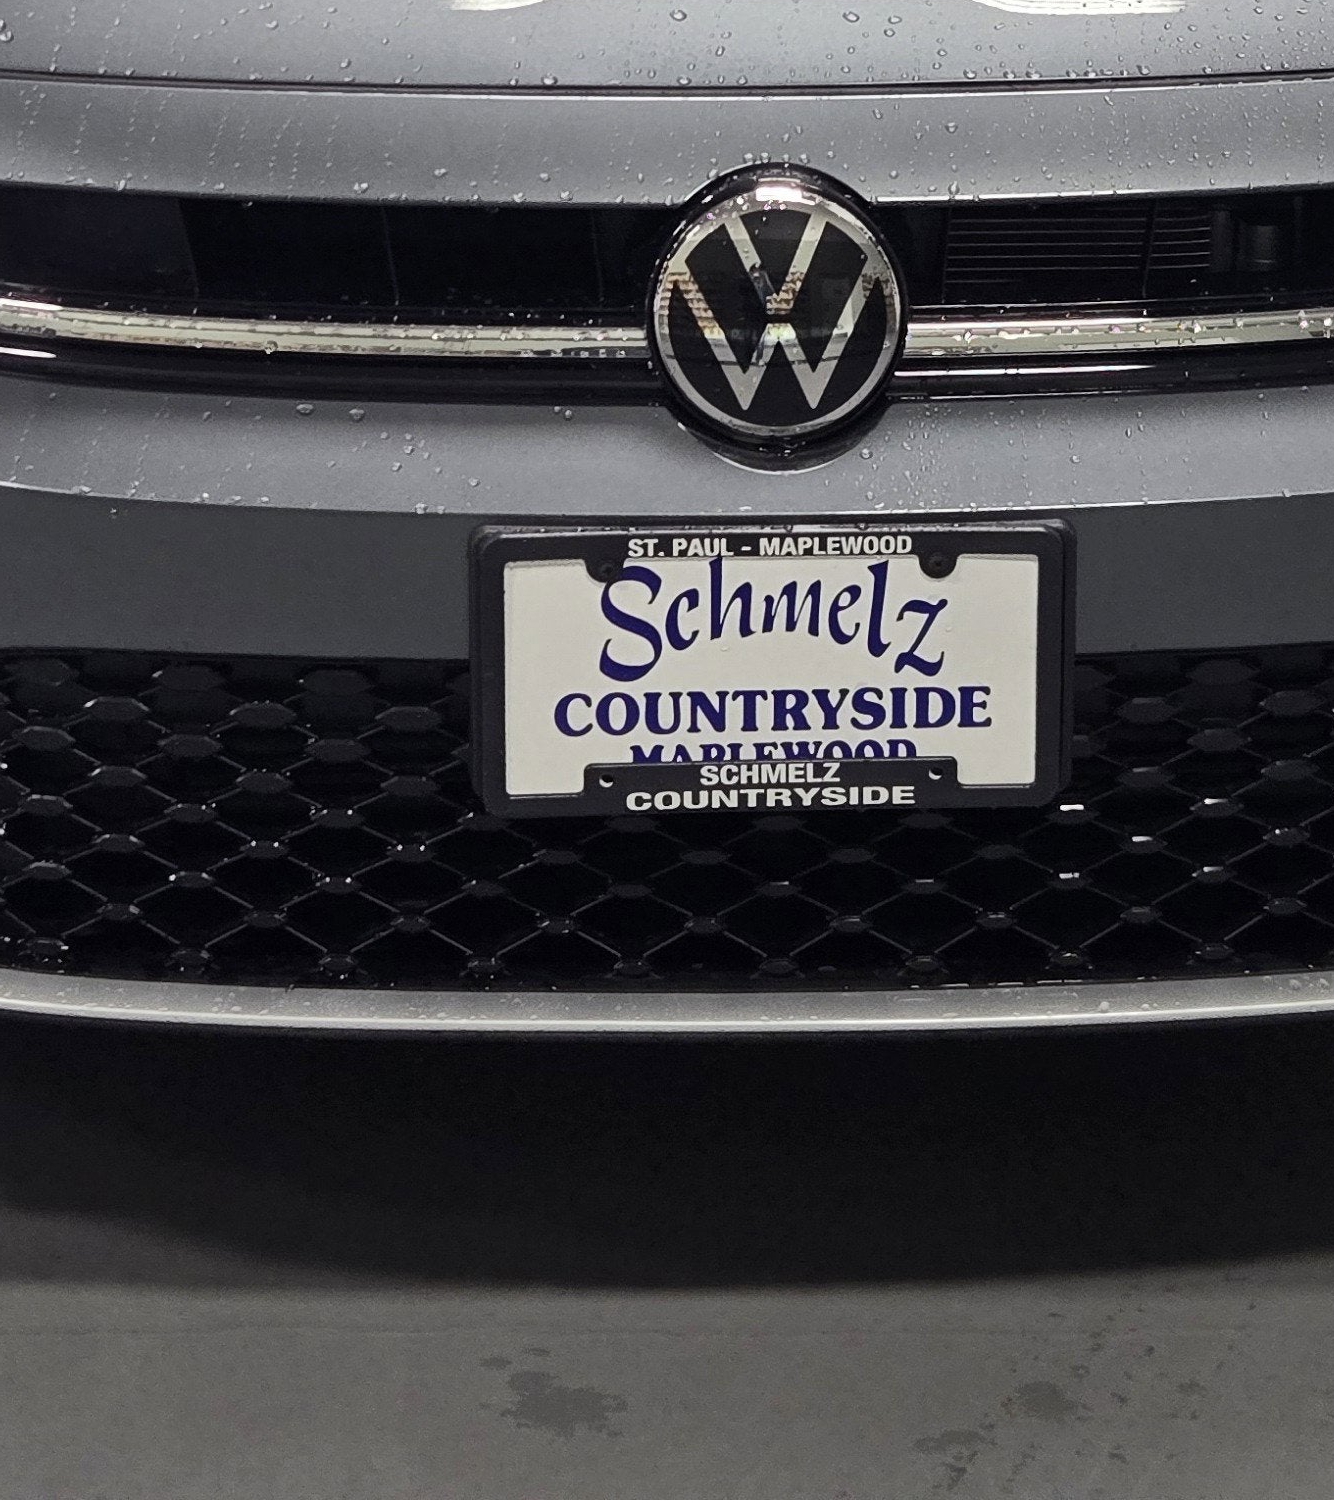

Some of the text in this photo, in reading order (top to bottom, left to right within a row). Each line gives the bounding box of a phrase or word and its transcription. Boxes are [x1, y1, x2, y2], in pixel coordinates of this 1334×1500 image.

[628, 538, 665, 557] ST.
[672, 537, 733, 557] PAUL
[759, 535, 912, 556] MAPLEWOOD
[599, 557, 948, 682] Schmelz
[554, 686, 992, 737] COUNTRYSIDE
[700, 762, 841, 786] SCHMELZ
[626, 786, 916, 811] COUNTRYSIDE
